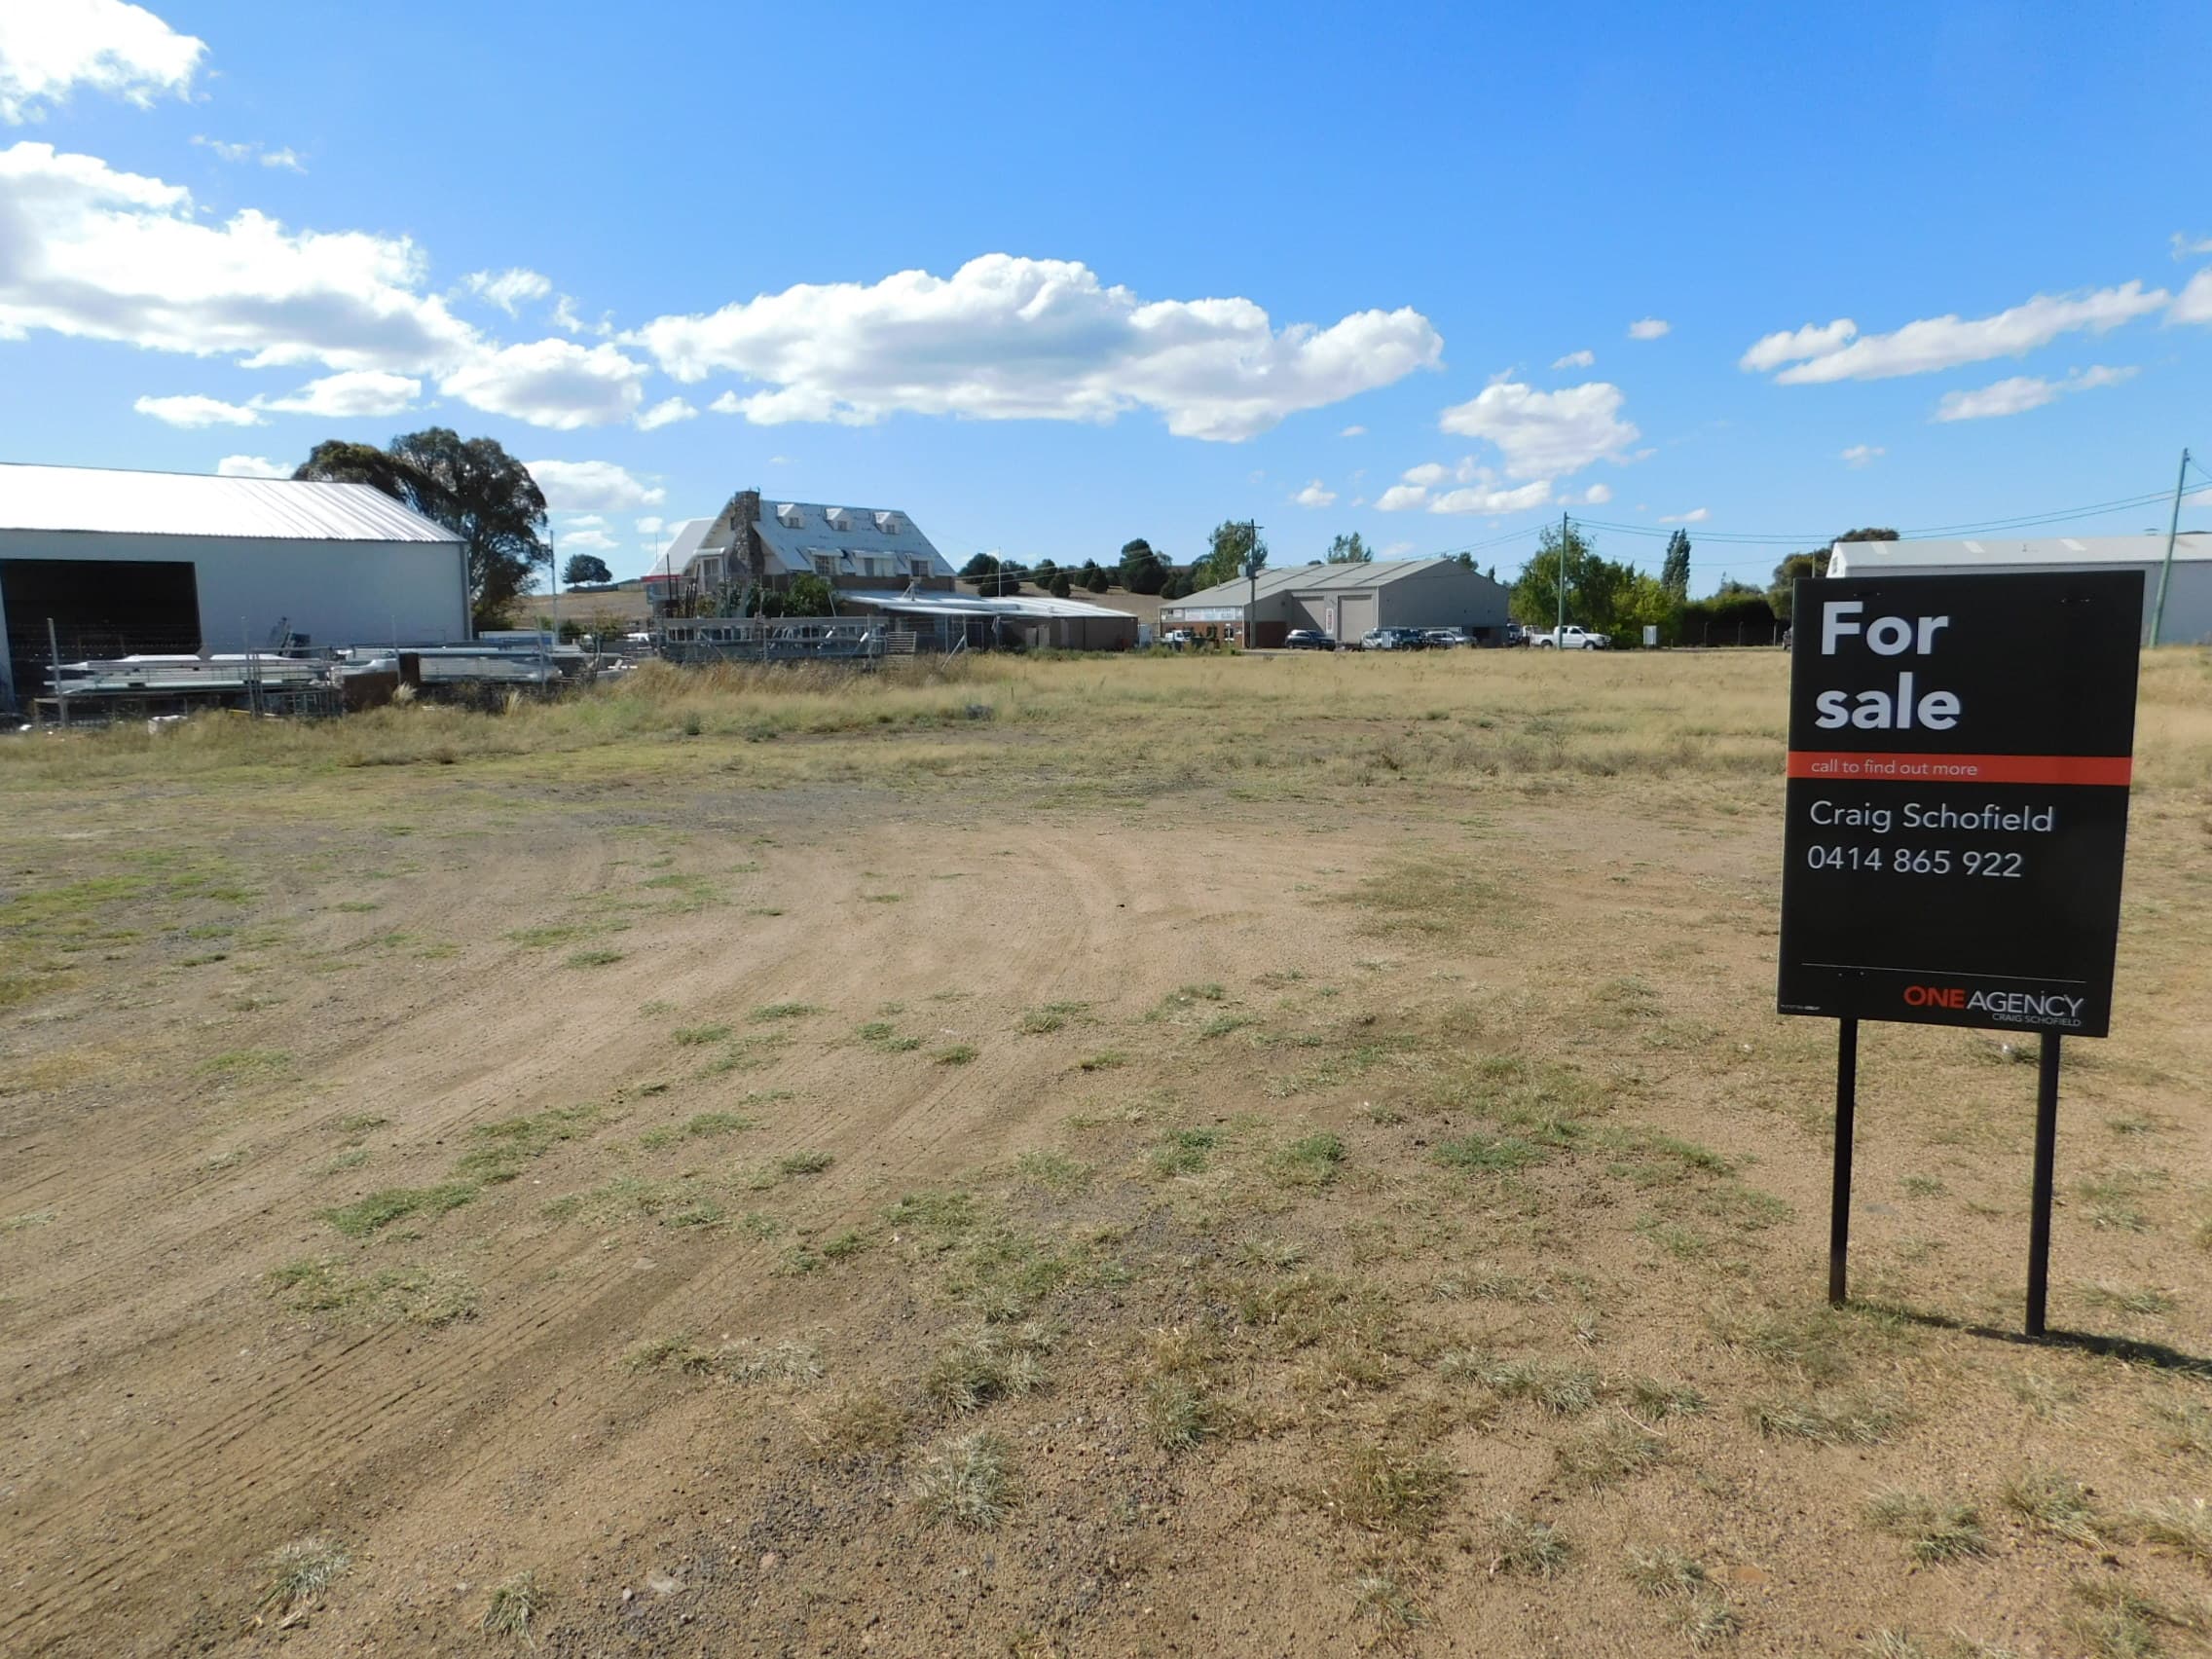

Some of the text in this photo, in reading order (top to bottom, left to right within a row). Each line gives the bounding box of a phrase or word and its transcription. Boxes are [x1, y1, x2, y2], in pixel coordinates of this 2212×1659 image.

[1822, 601, 1949, 656] For
[1815, 672, 1961, 730] sale
[1811, 758, 1978, 776] call to find out more
[1809, 800, 2054, 833] Craig Schofield
[1807, 845, 2022, 877] 0414 865 922
[1992, 1013, 2082, 1027] CRAIG SCHOFIELD
